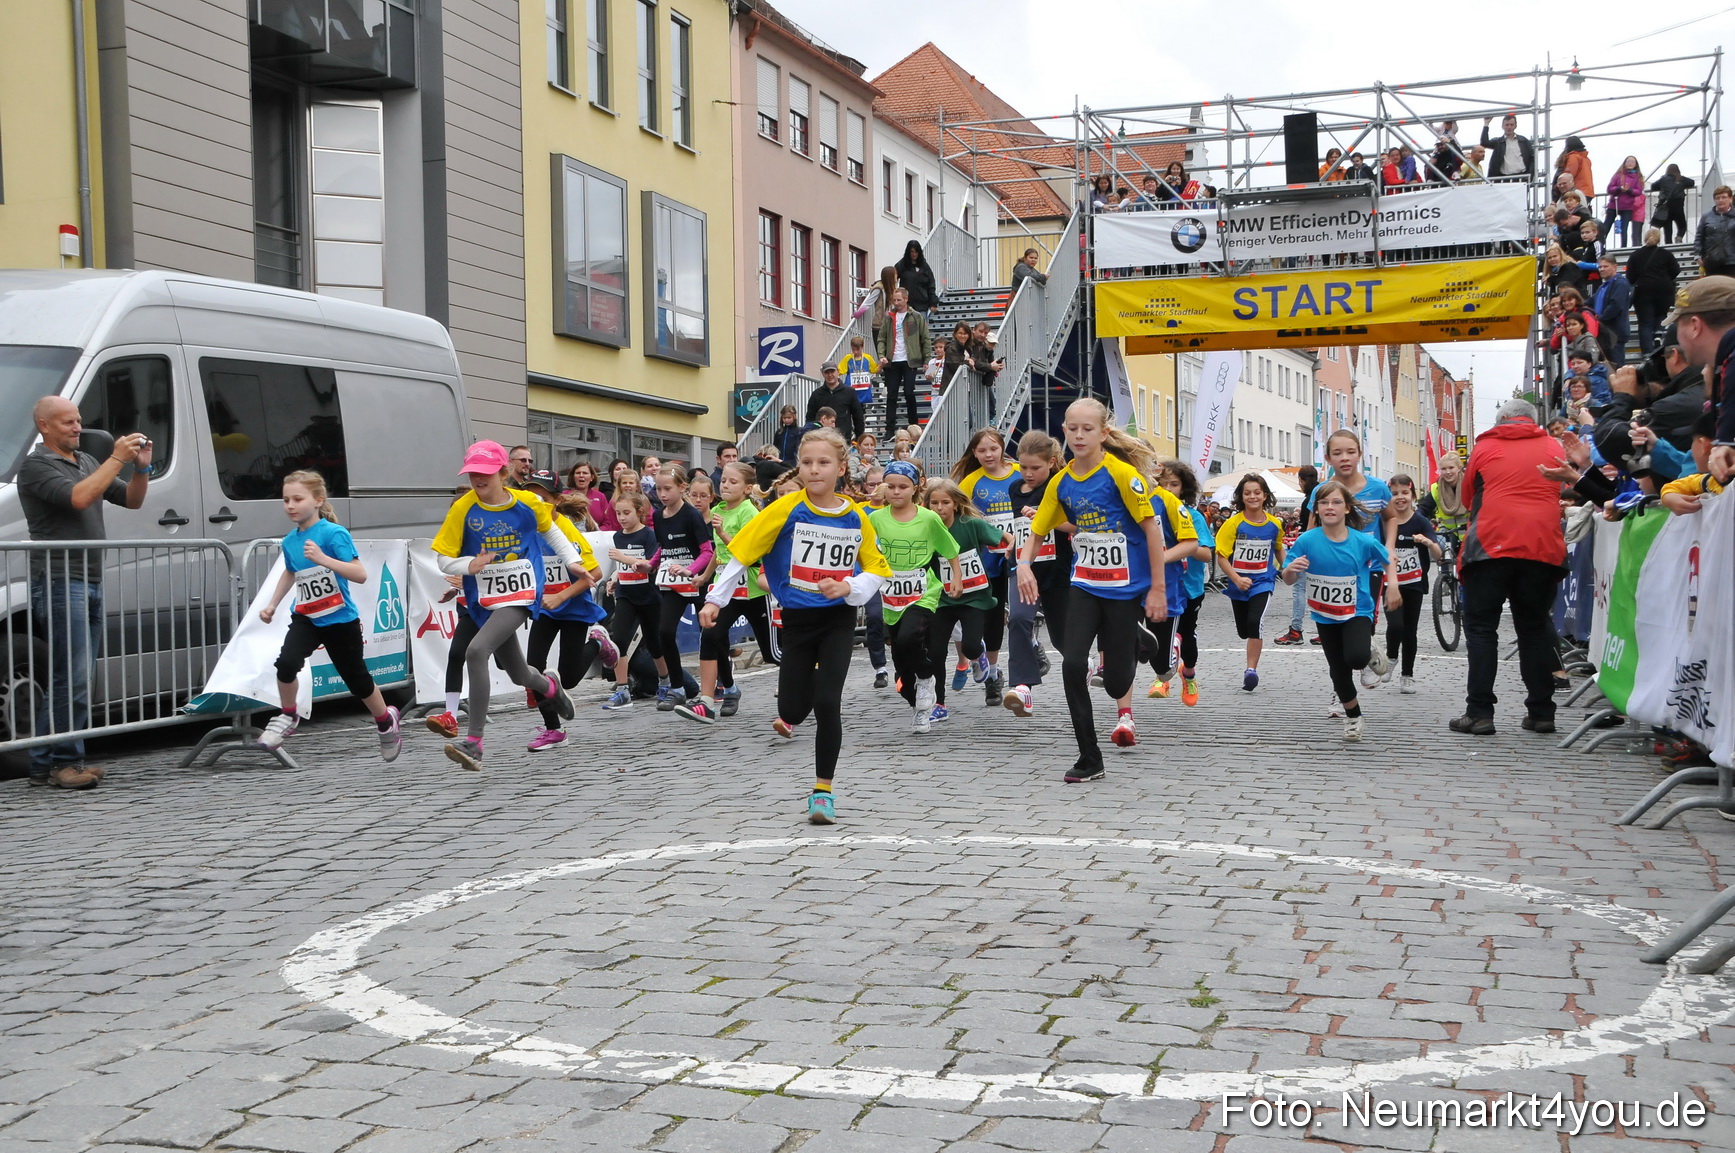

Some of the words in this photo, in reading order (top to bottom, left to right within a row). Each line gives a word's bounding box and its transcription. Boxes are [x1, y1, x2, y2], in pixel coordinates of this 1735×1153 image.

[1216, 219, 1264, 235] BMW
[1270, 205, 1441, 232] EfficientDynamics
[1216, 236, 1266, 249] Weniger
[1268, 231, 1333, 245] Verbrauch.
[1337, 228, 1368, 241] Mehr
[1232, 279, 1383, 321] START
[1410, 293, 1464, 304] Neumarkter
[1466, 289, 1509, 300] Stadtlauf
[1118, 308, 1167, 318] Neumarkter
[1168, 307, 1208, 316] Stadtlauf
[852, 376, 869, 384] 7210
[1199, 434, 1213, 469] Audi
[1207, 401, 1220, 431] BKK
[796, 529, 820, 538] PARTL
[821, 532, 852, 541] Neumarkt
[800, 539, 855, 567] 7196
[1079, 545, 1122, 566] 7130
[1239, 547, 1268, 561] 7049
[496, 565, 524, 573] Neumarkt
[545, 565, 562, 583] 37
[943, 559, 980, 581] 776
[298, 576, 334, 602] 7063
[482, 571, 531, 595] 7560
[885, 579, 923, 596] 7004
[1310, 584, 1352, 604] 7028
